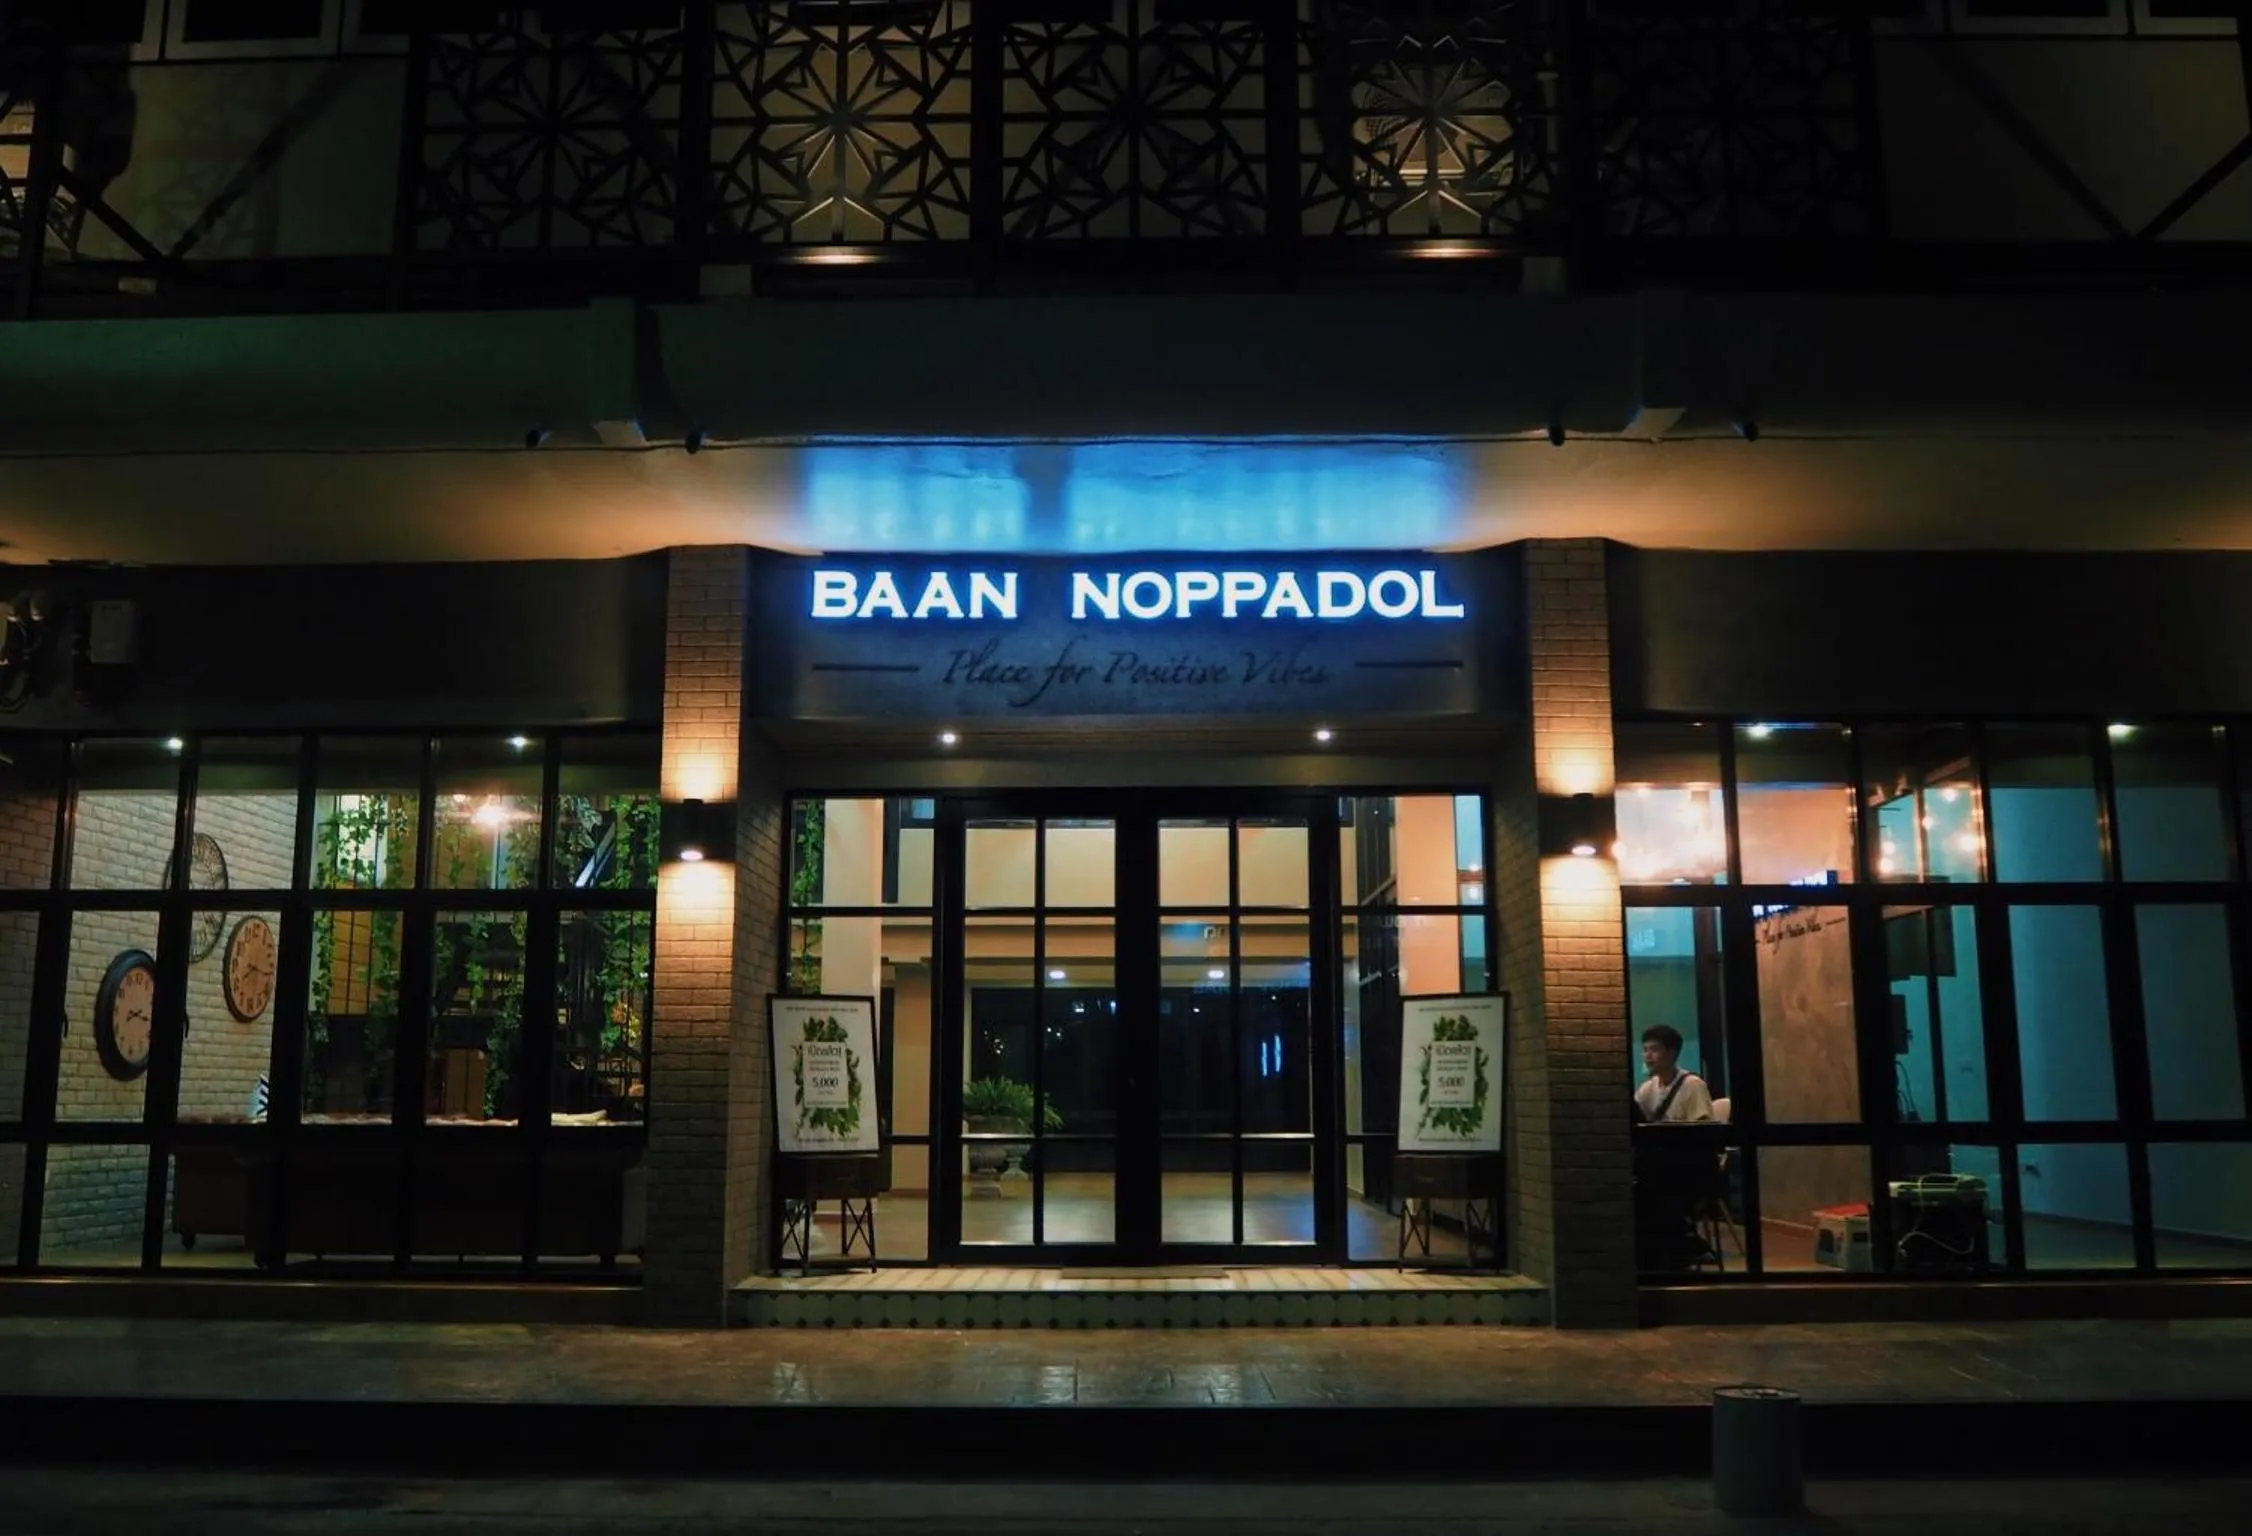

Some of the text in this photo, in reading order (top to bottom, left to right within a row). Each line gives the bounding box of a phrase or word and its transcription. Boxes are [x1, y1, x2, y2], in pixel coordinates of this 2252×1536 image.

[810, 568, 1465, 620] BAAN NOPPADOL
[943, 631, 1334, 708] Place for Positive Vibes
